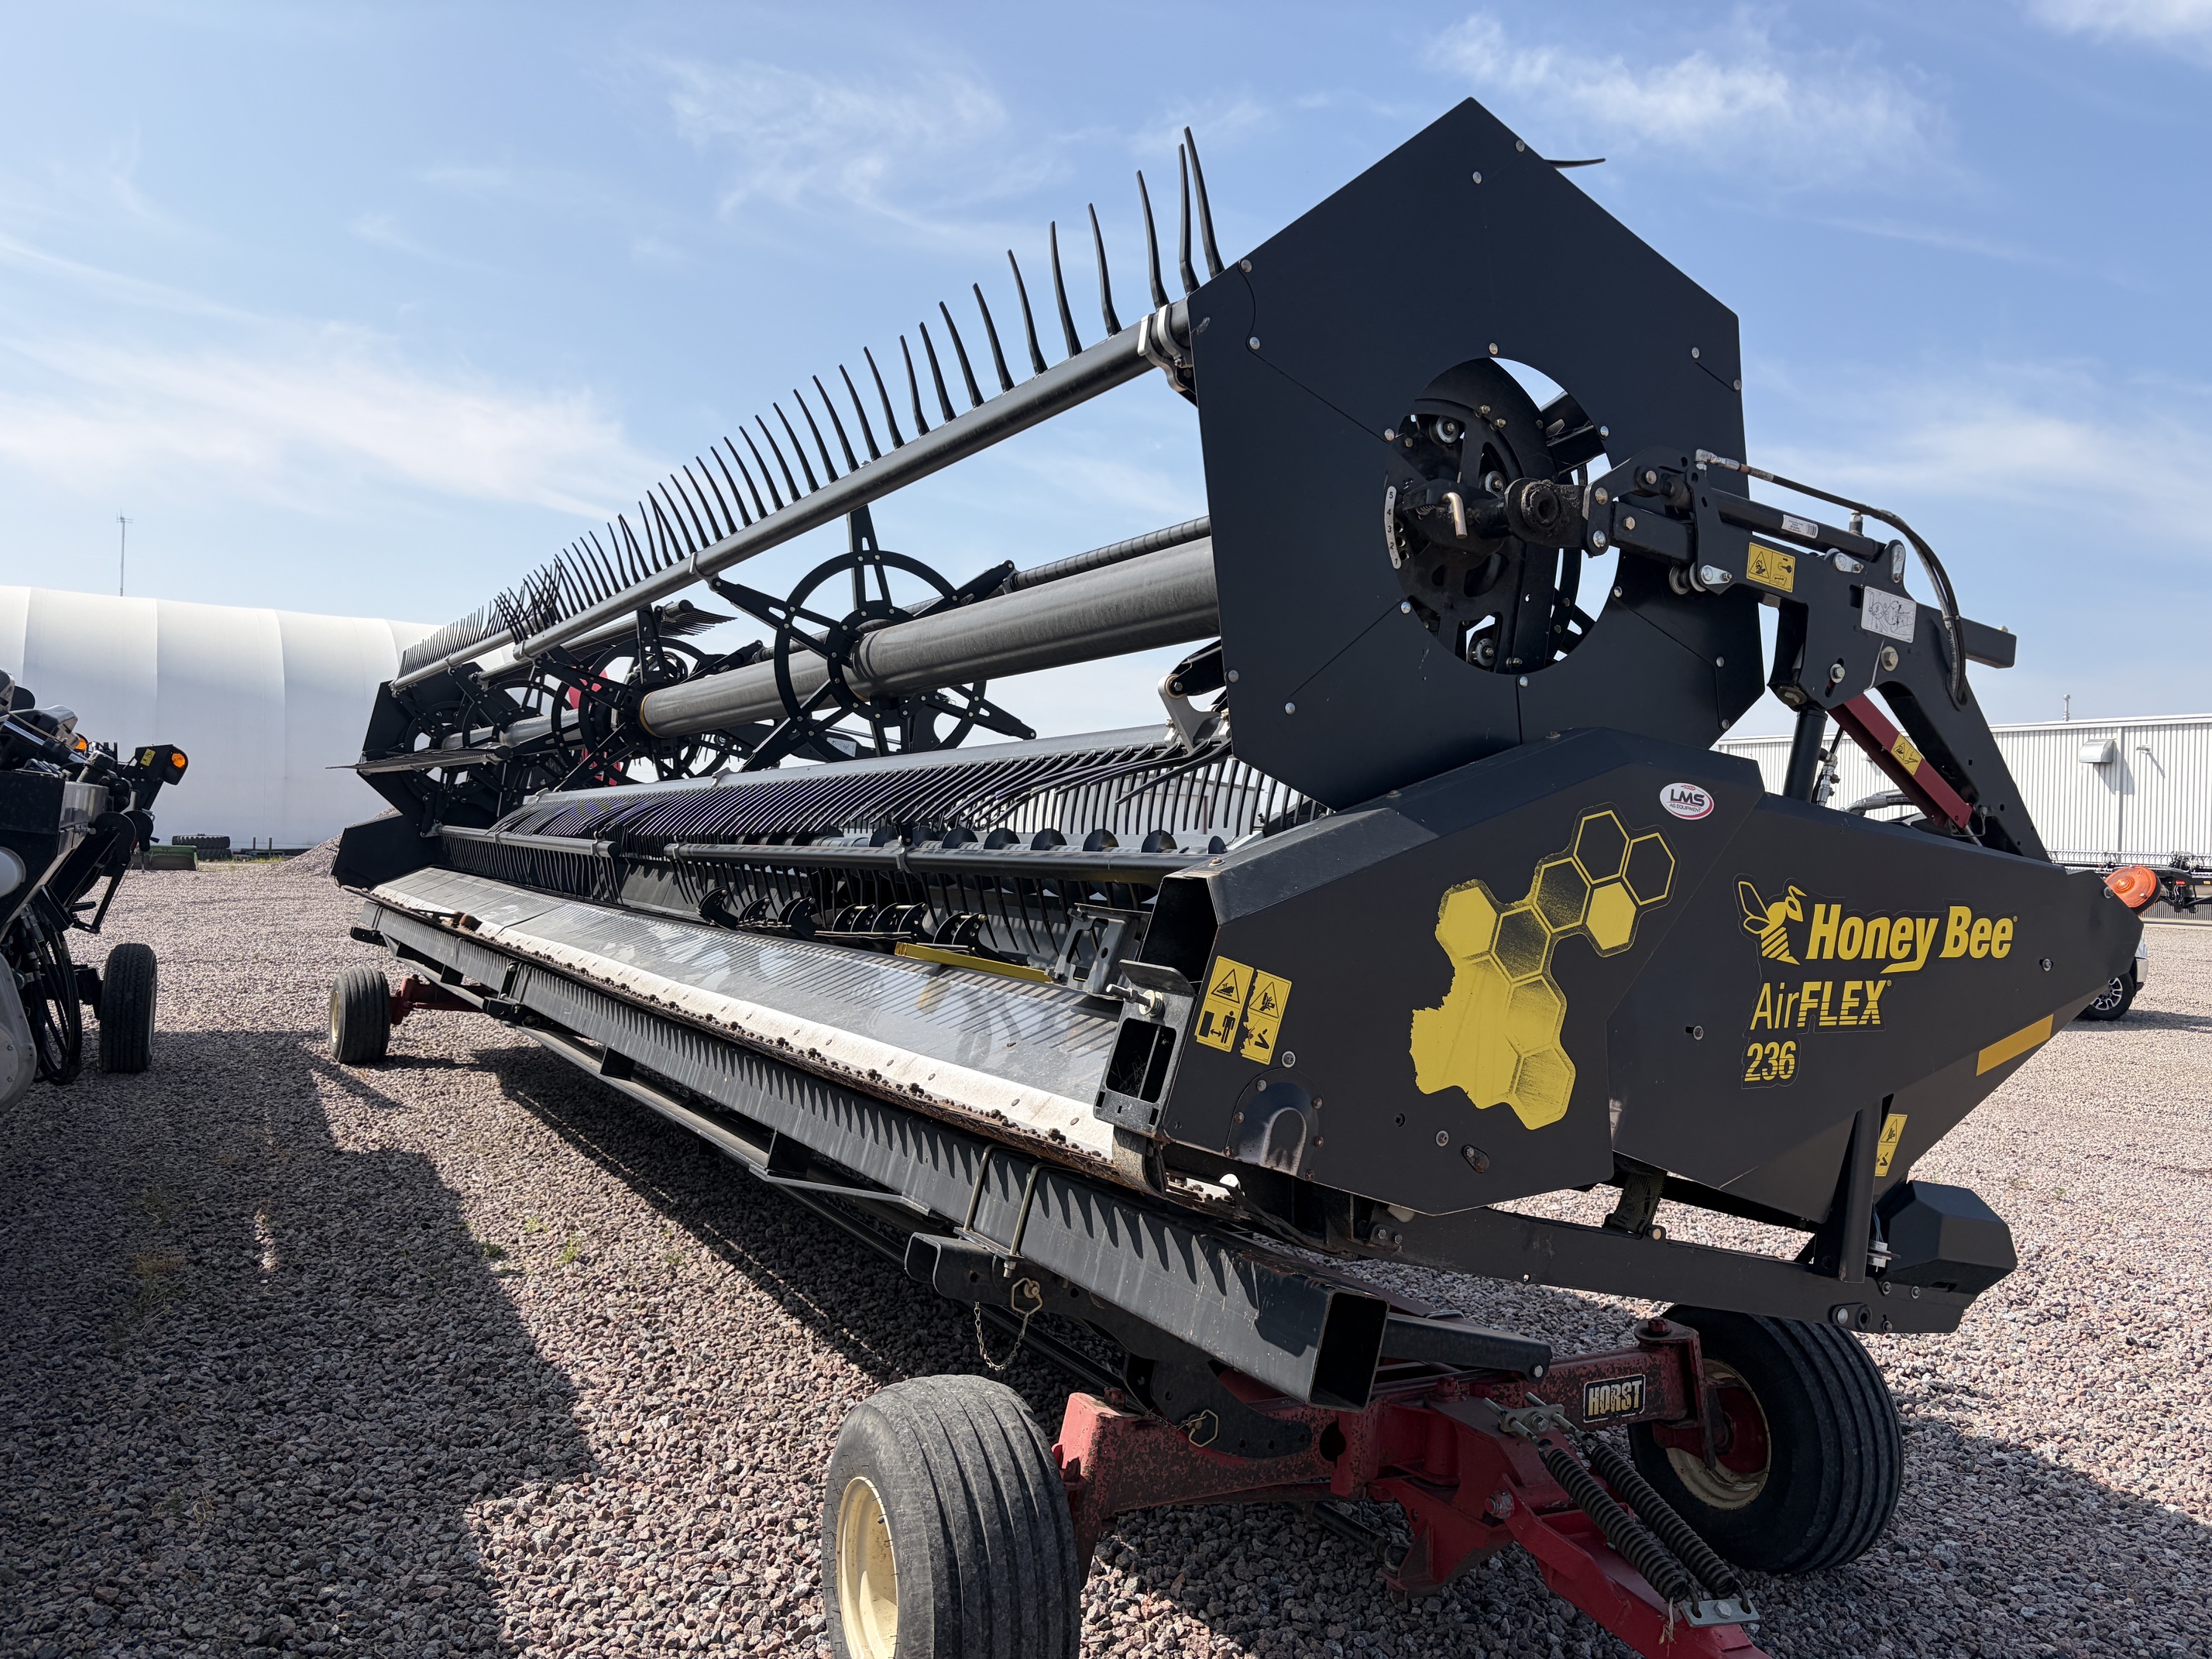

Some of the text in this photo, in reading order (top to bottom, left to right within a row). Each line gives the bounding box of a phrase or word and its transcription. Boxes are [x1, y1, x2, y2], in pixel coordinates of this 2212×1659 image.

[1670, 788, 1705, 807] LMS
[1676, 804, 1702, 812] EQUIPMENT
[1805, 903, 2014, 974] Honey Bee
[1750, 980, 1887, 1030] AirFLEX
[1744, 1040, 1796, 1082] 236
[1588, 1379, 1643, 1417] HORST
